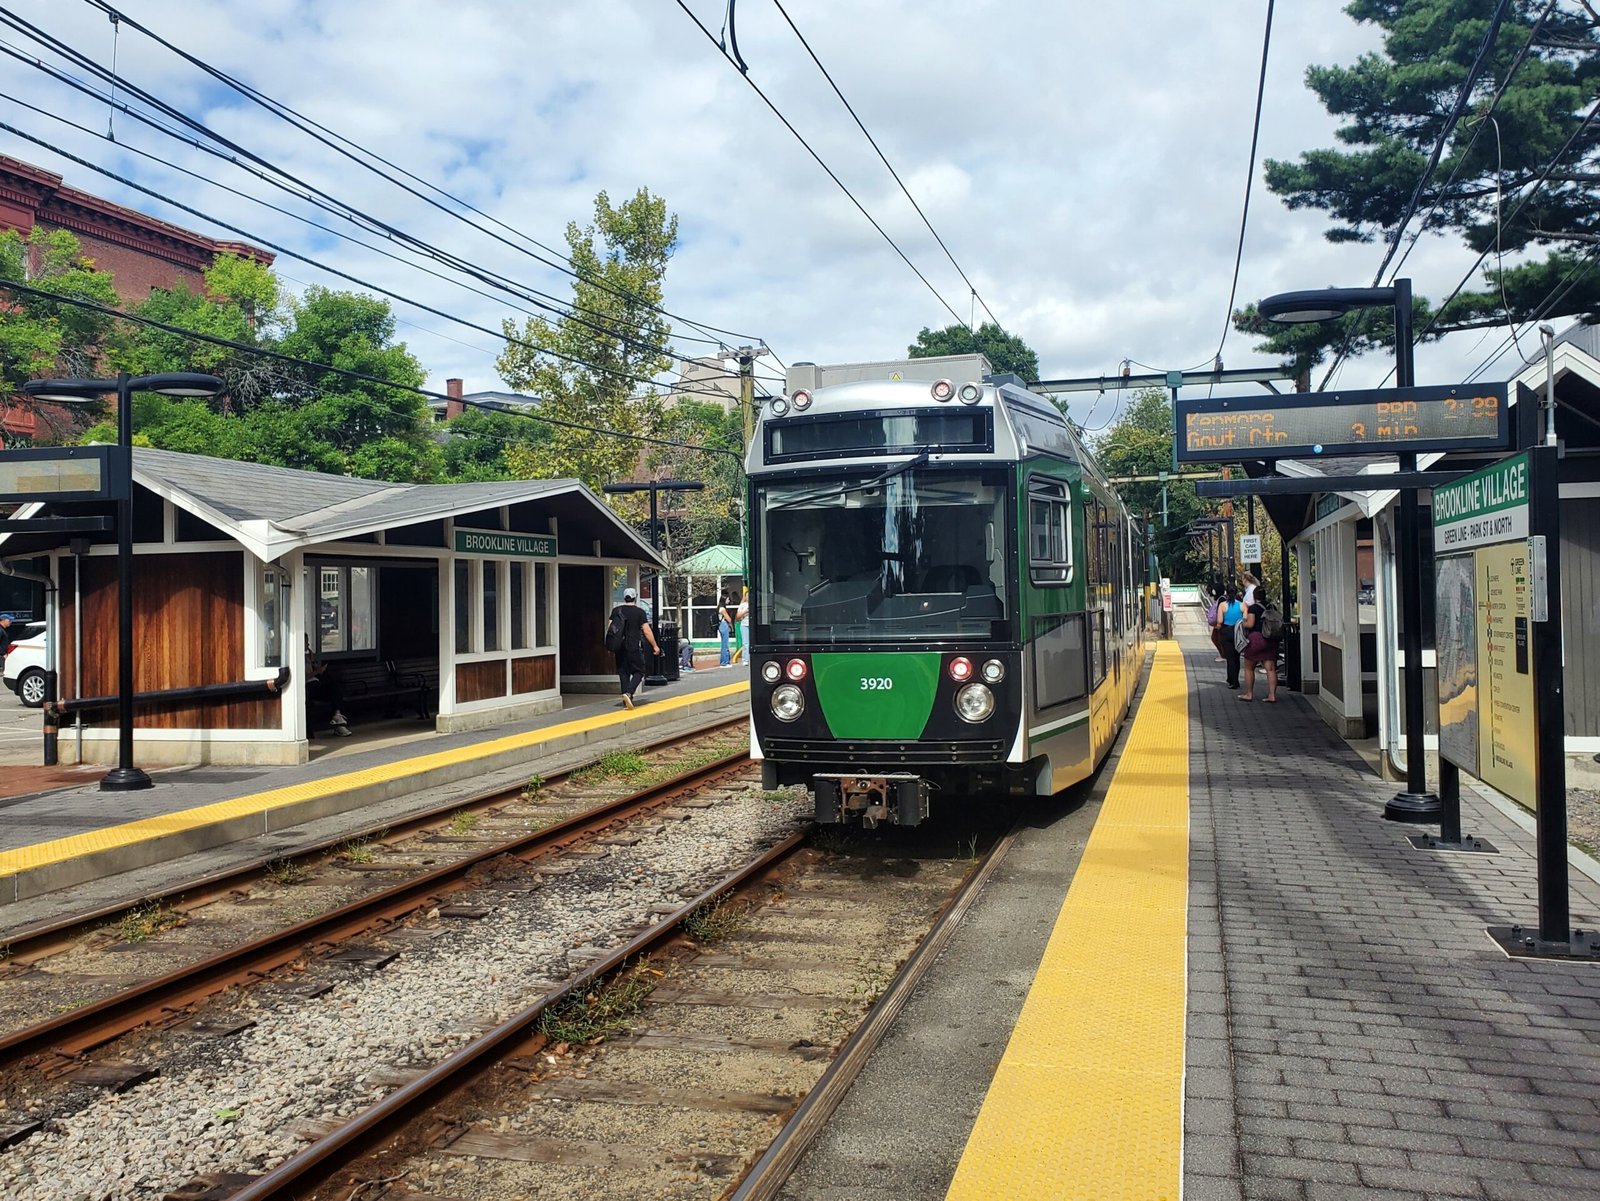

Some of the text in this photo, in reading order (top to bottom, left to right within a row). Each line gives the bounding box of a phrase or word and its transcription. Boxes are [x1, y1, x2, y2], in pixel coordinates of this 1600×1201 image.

[1435, 462, 1525, 521] BROOKLINE VILLAGE
[1444, 527, 1457, 545] GREEN
[1458, 525, 1467, 541] LINE
[1470, 523, 1482, 540] PARK
[1483, 521, 1489, 537] ST
[1489, 522, 1493, 536] &
[1494, 515, 1512, 535] NORTH
[466, 534, 549, 553] BROOKLINE VILLAGE
[860, 677, 893, 690] 3920
